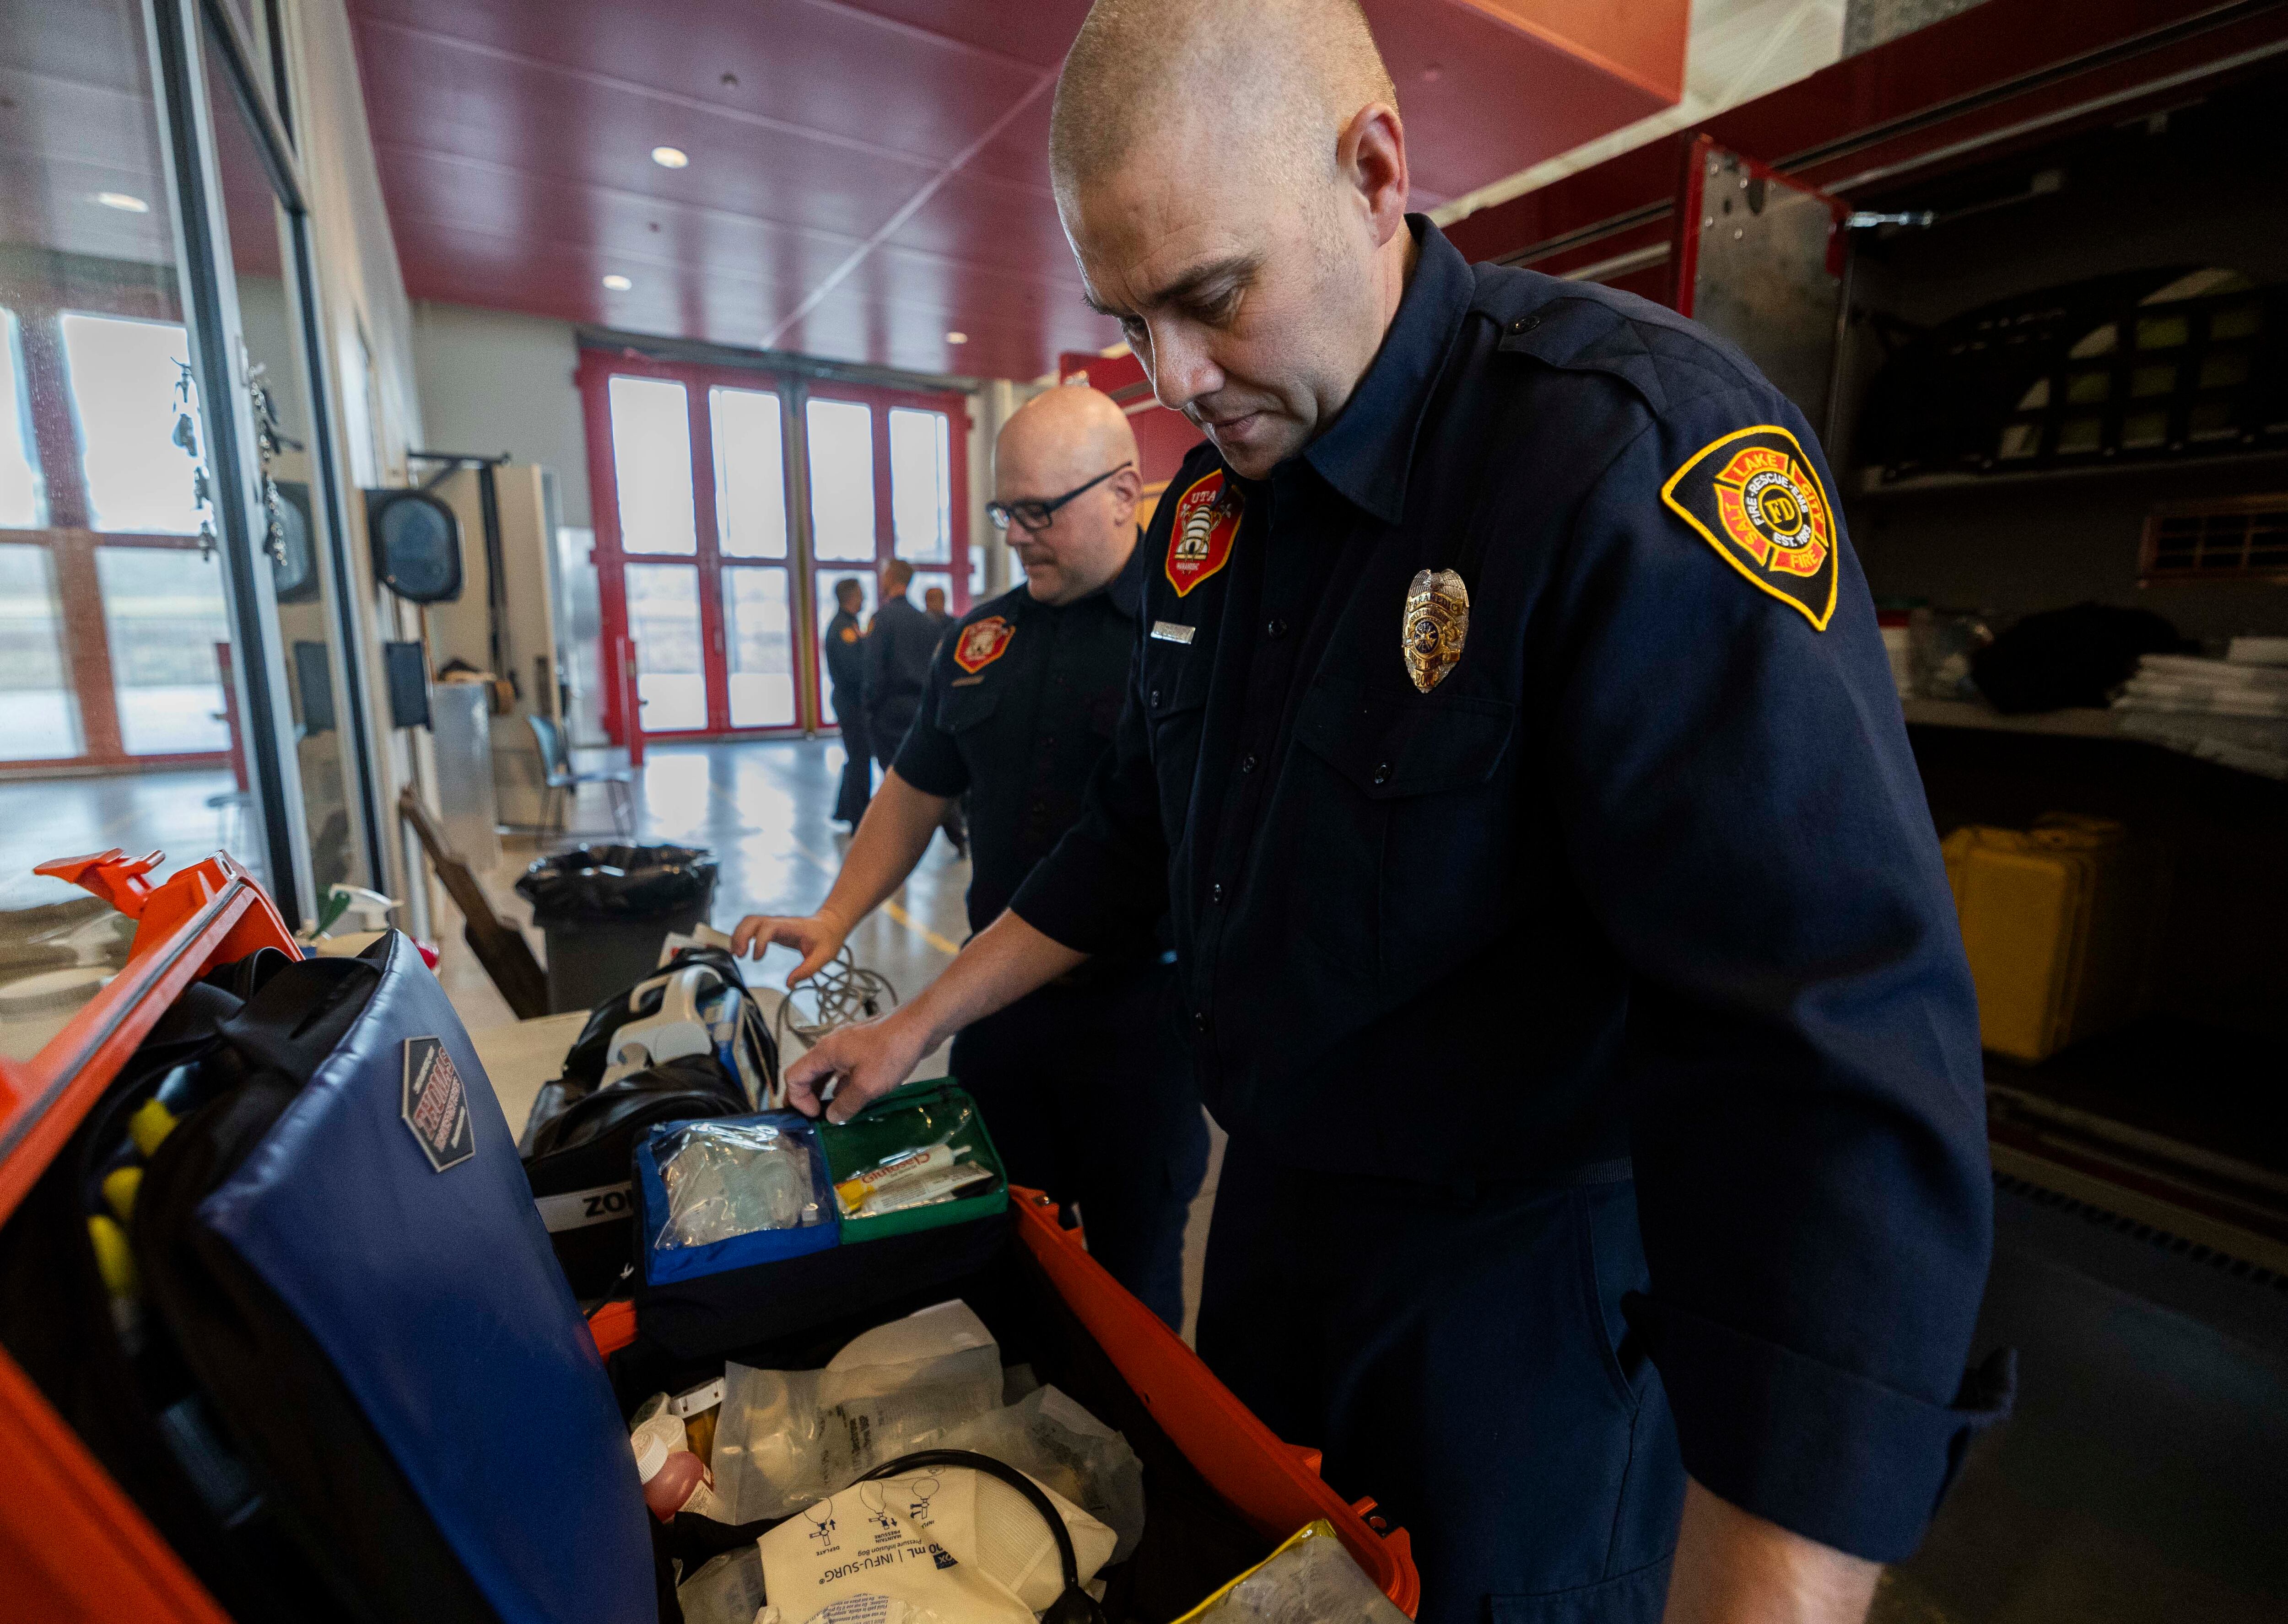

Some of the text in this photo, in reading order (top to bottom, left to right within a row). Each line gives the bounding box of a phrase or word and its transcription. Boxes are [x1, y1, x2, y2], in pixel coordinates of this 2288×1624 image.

[1732, 454, 1778, 477] LAKE
[1191, 490, 1217, 504] UTA
[1745, 473, 1809, 526] FIRE RESCUE EMS
[1802, 484, 1824, 524] CITY
[1765, 497, 1796, 524] FD
[1725, 501, 1759, 546] SALT
[1773, 533, 1797, 548] EST.
[1790, 548, 1818, 569] FIRE
[1409, 593, 1458, 614] PARAMEDIC
[874, 1530, 901, 1539] PRESSURE
[875, 1534, 902, 1543] MAINTAIN
[816, 1545, 840, 1556] DEFLATE
[871, 1543, 896, 1553] Infusion
[897, 1538, 922, 1548] Pressure
[907, 1547, 926, 1558] mL
